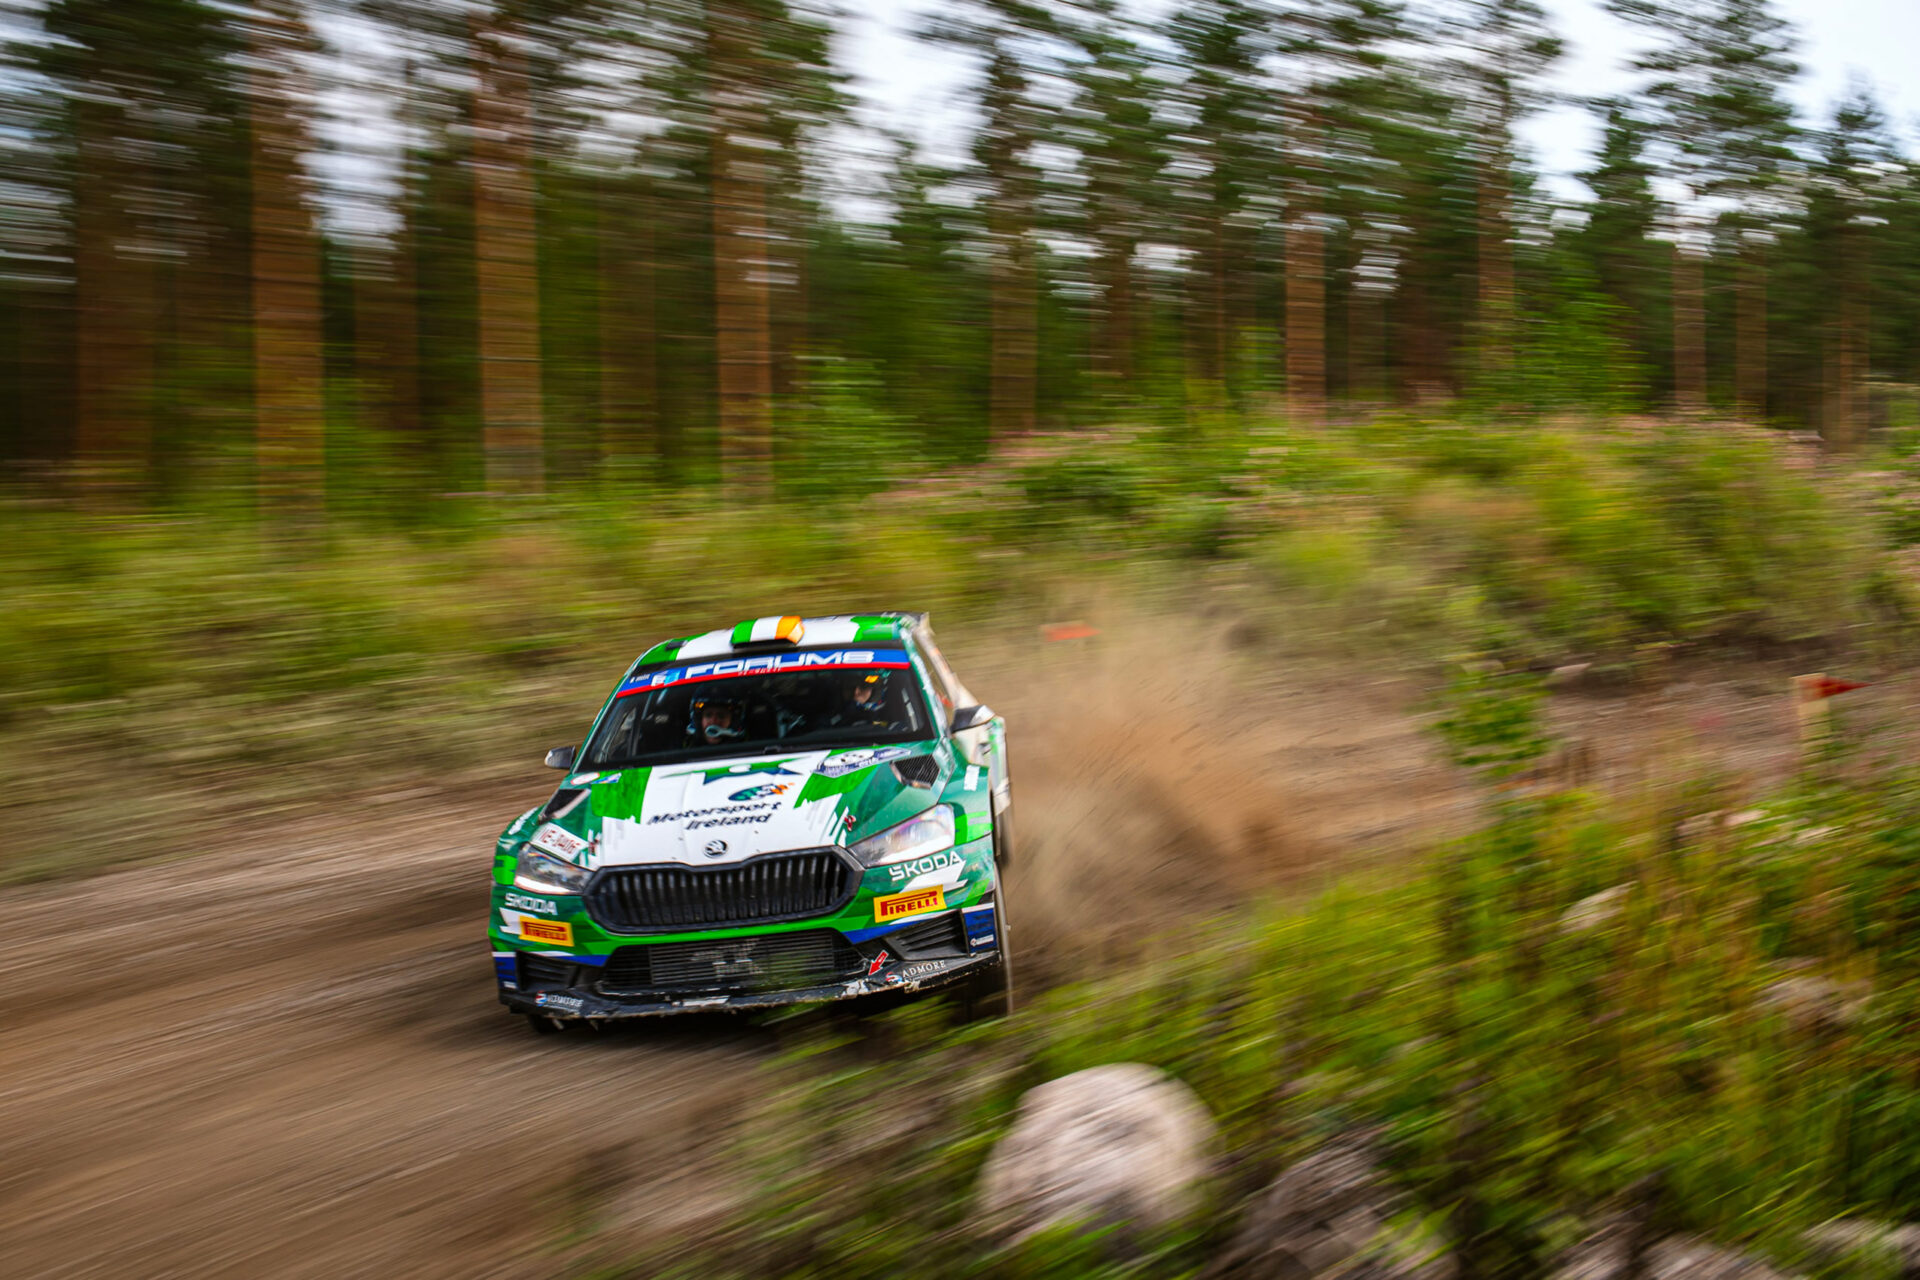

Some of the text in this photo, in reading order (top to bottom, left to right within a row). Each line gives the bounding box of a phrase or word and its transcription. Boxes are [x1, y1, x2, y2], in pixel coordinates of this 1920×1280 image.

[647, 802, 782, 825] Motorsport
[686, 813, 772, 830] Ireland
[880, 890, 938, 916] PIRELLI
[520, 921, 568, 941] PIRELLI
[902, 960, 946, 978] ADMORE
